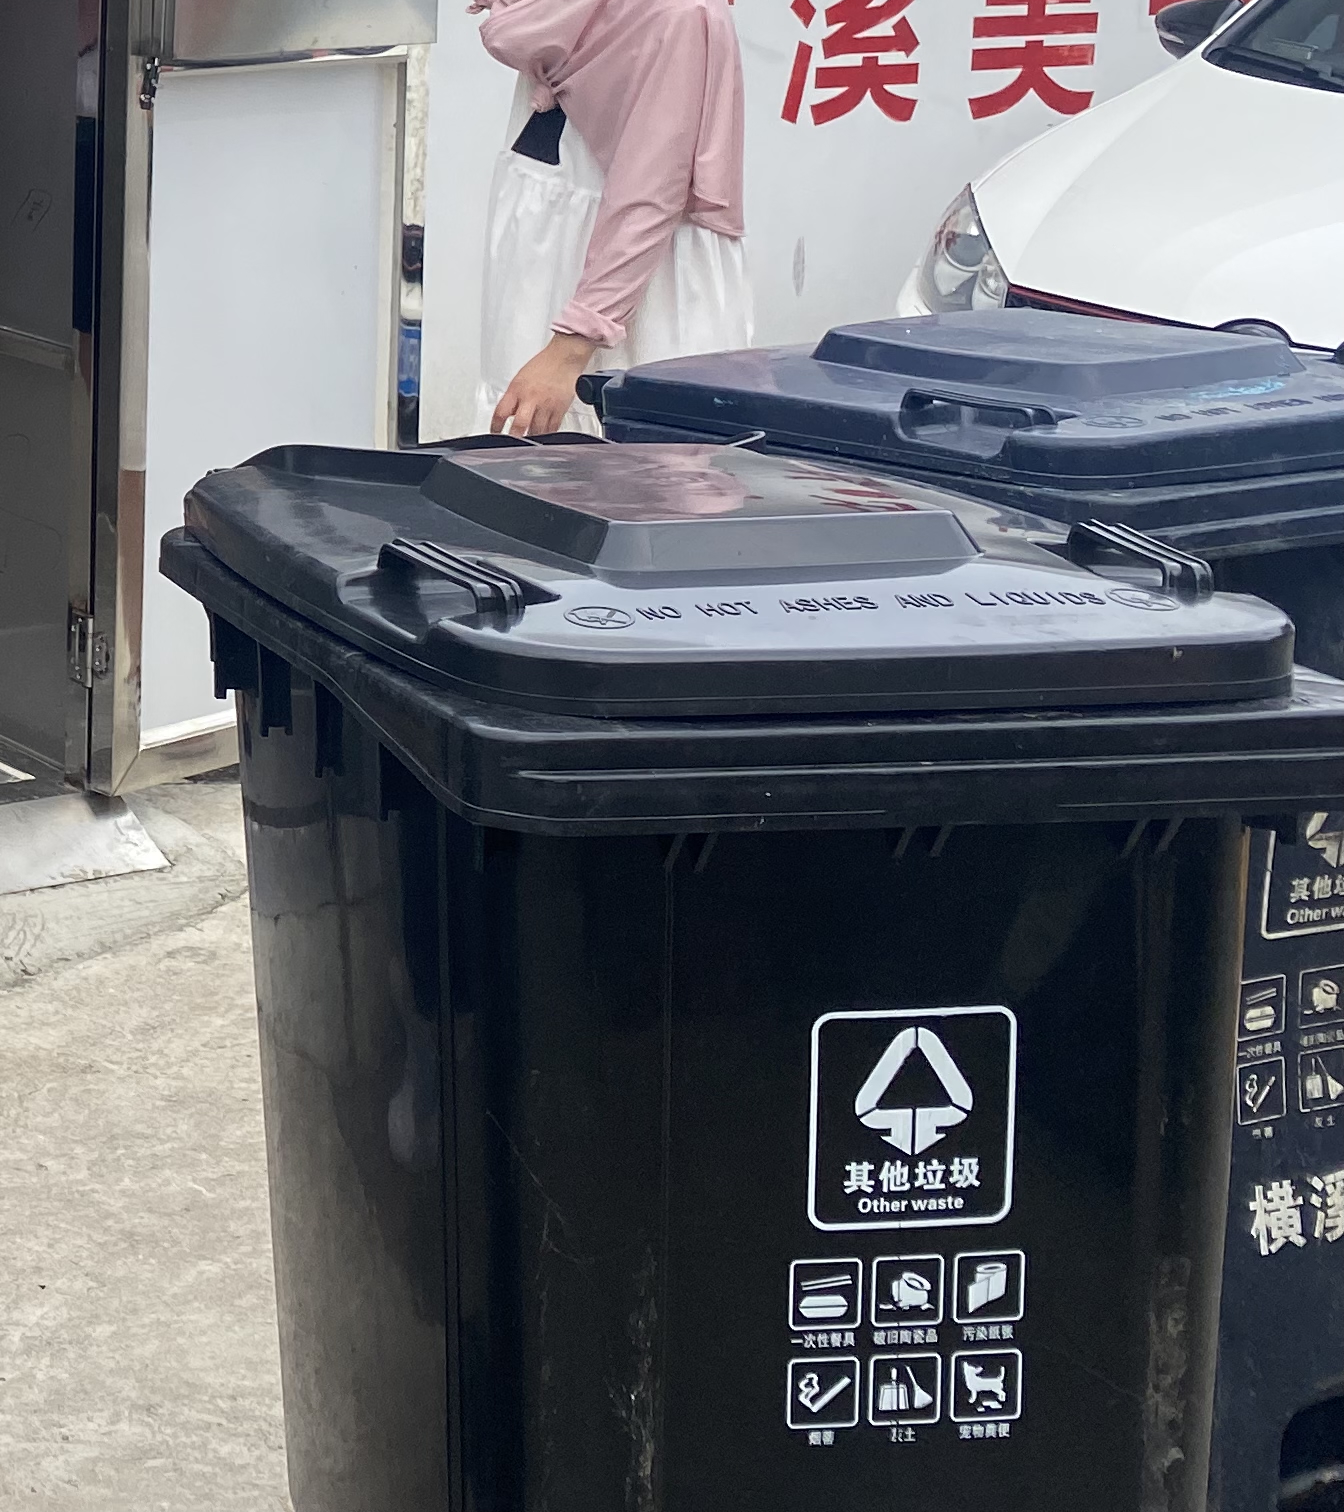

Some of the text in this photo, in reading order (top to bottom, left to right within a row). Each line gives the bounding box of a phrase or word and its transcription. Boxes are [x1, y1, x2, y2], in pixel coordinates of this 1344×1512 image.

[636, 589, 1109, 622] NO HOT ASHES AND LIQUIDS
[1287, 908, 1329, 924] Other
[843, 1157, 981, 1194] 其他垃圾
[858, 1196, 964, 1213] Other waste
[790, 1332, 855, 1349] 一次性餐具
